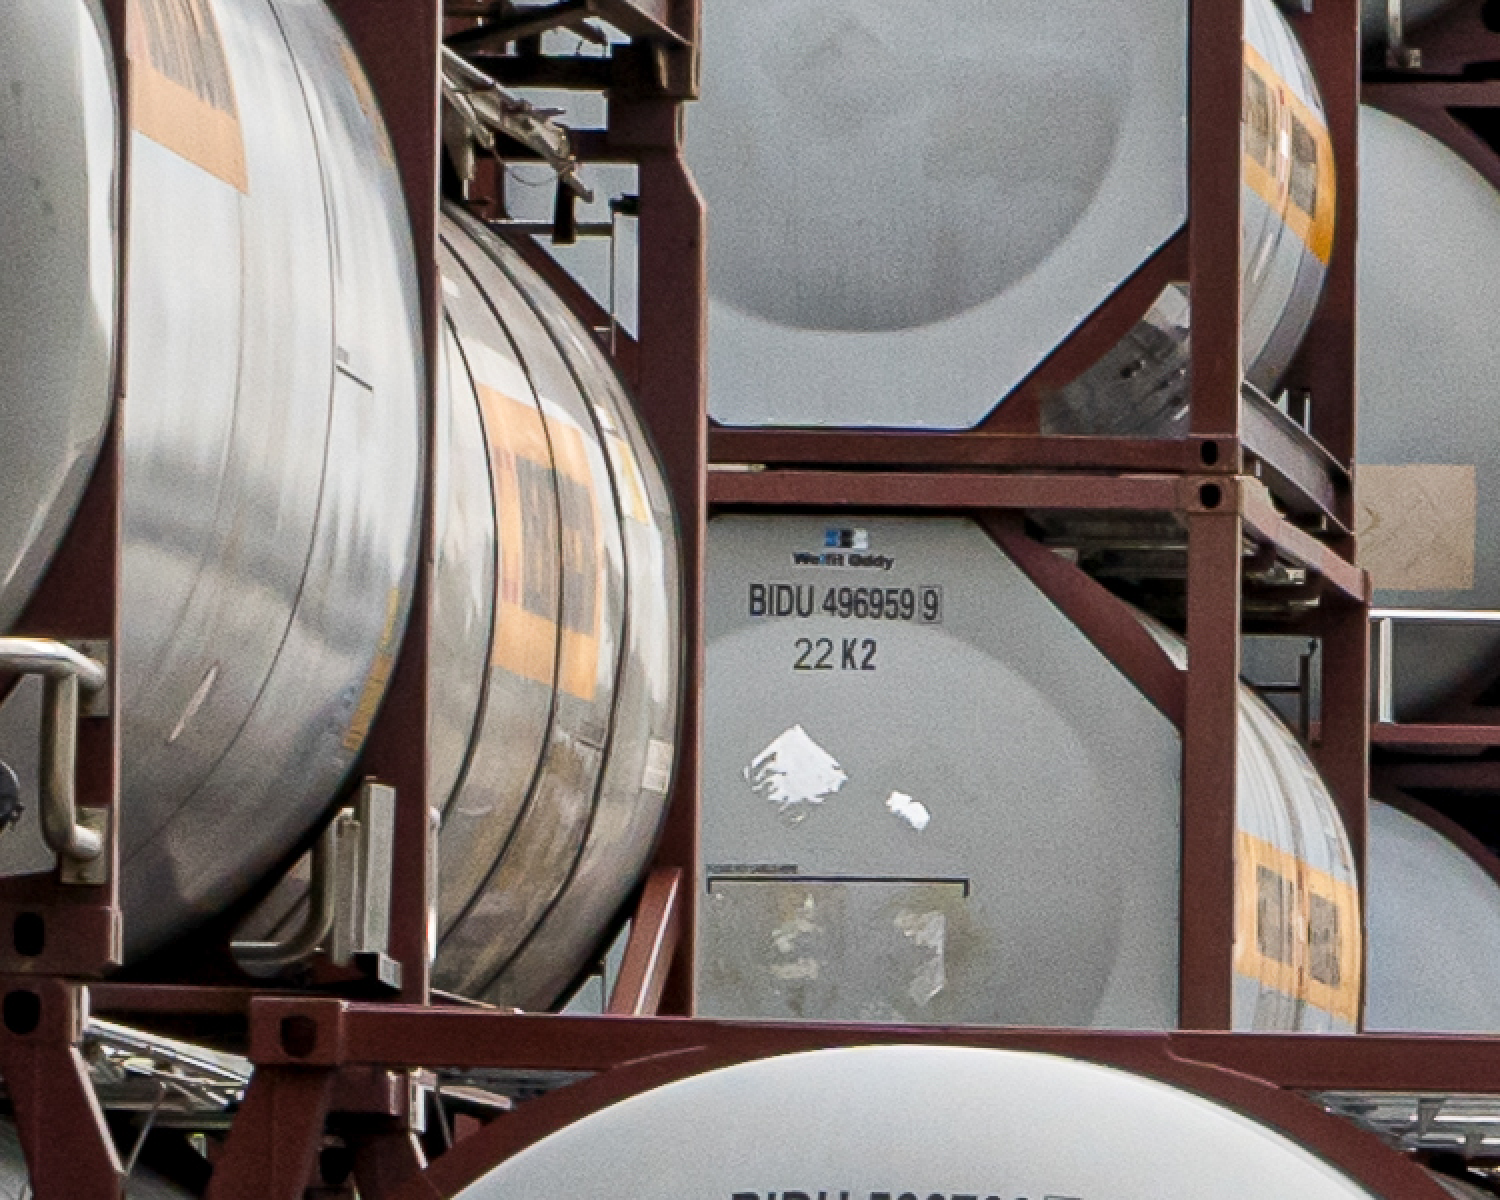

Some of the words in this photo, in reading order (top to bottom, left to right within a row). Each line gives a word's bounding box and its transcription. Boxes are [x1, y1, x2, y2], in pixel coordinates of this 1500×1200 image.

[749, 583, 814, 618] BIDU
[821, 586, 915, 620] 496959
[921, 587, 940, 622] 9
